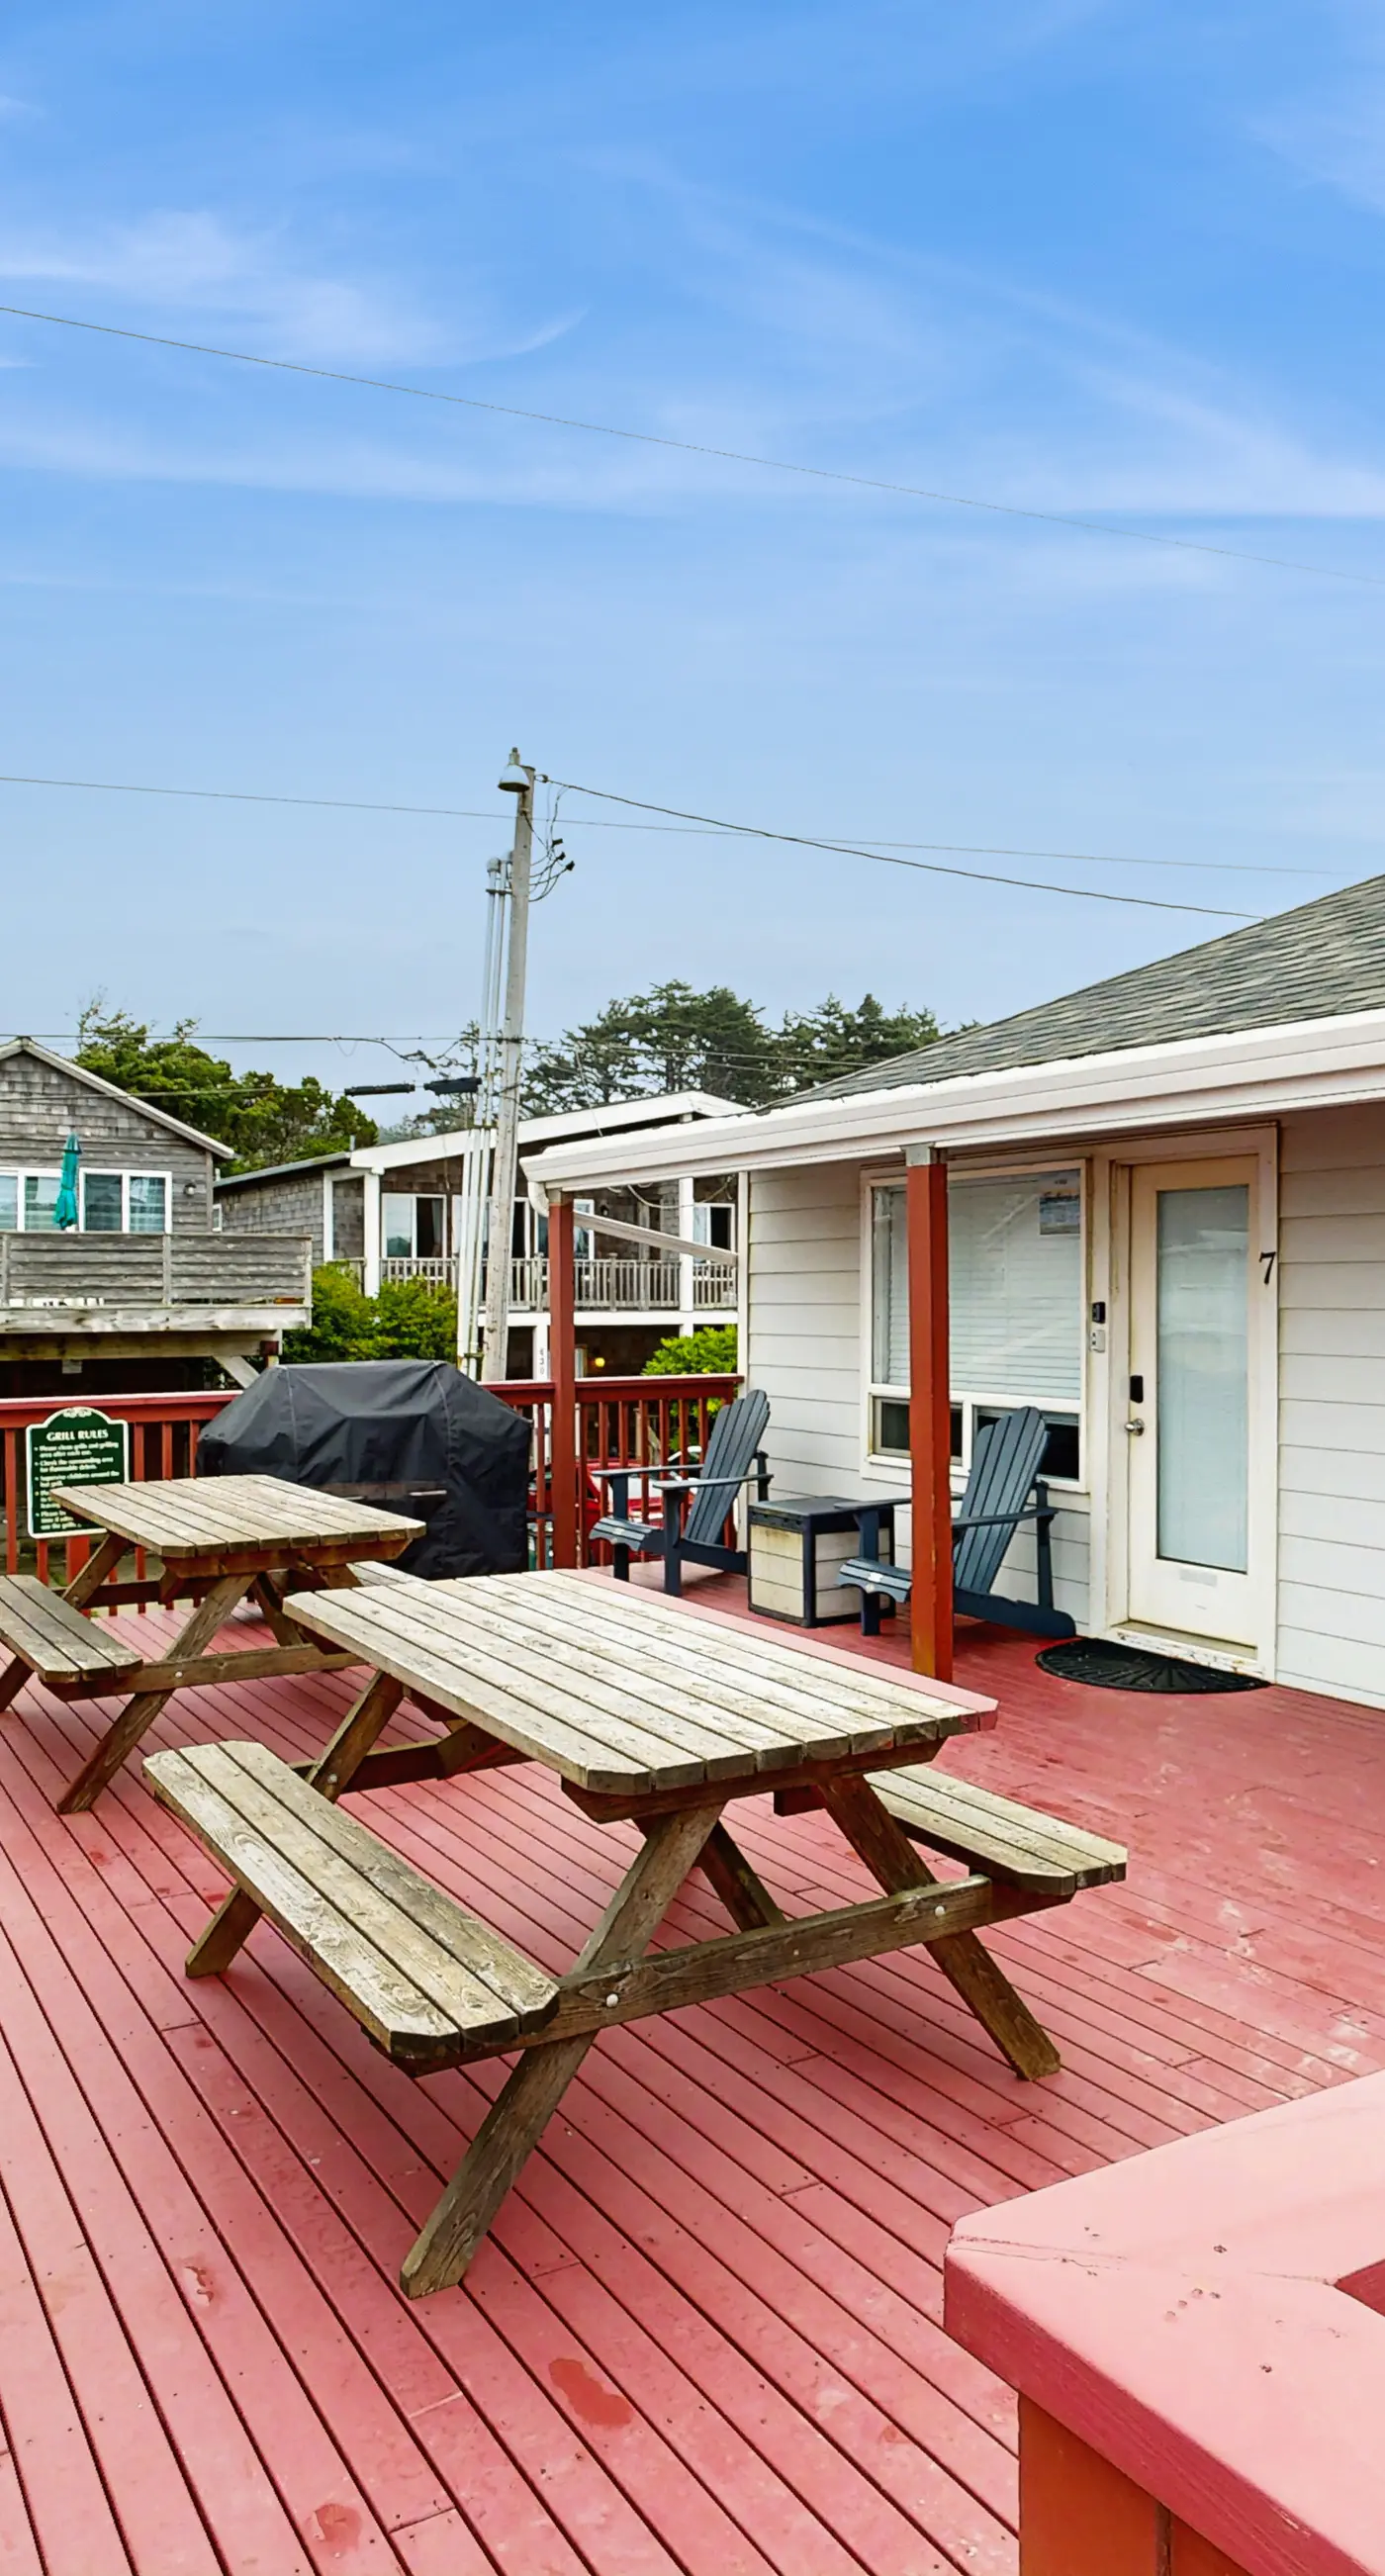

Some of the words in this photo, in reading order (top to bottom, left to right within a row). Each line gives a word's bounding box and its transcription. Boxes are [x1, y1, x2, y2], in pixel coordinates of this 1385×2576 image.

[1258, 1251, 1276, 1285] 7
[46, 1430, 75, 1441] GRILL
[77, 1428, 109, 1439] RULES
